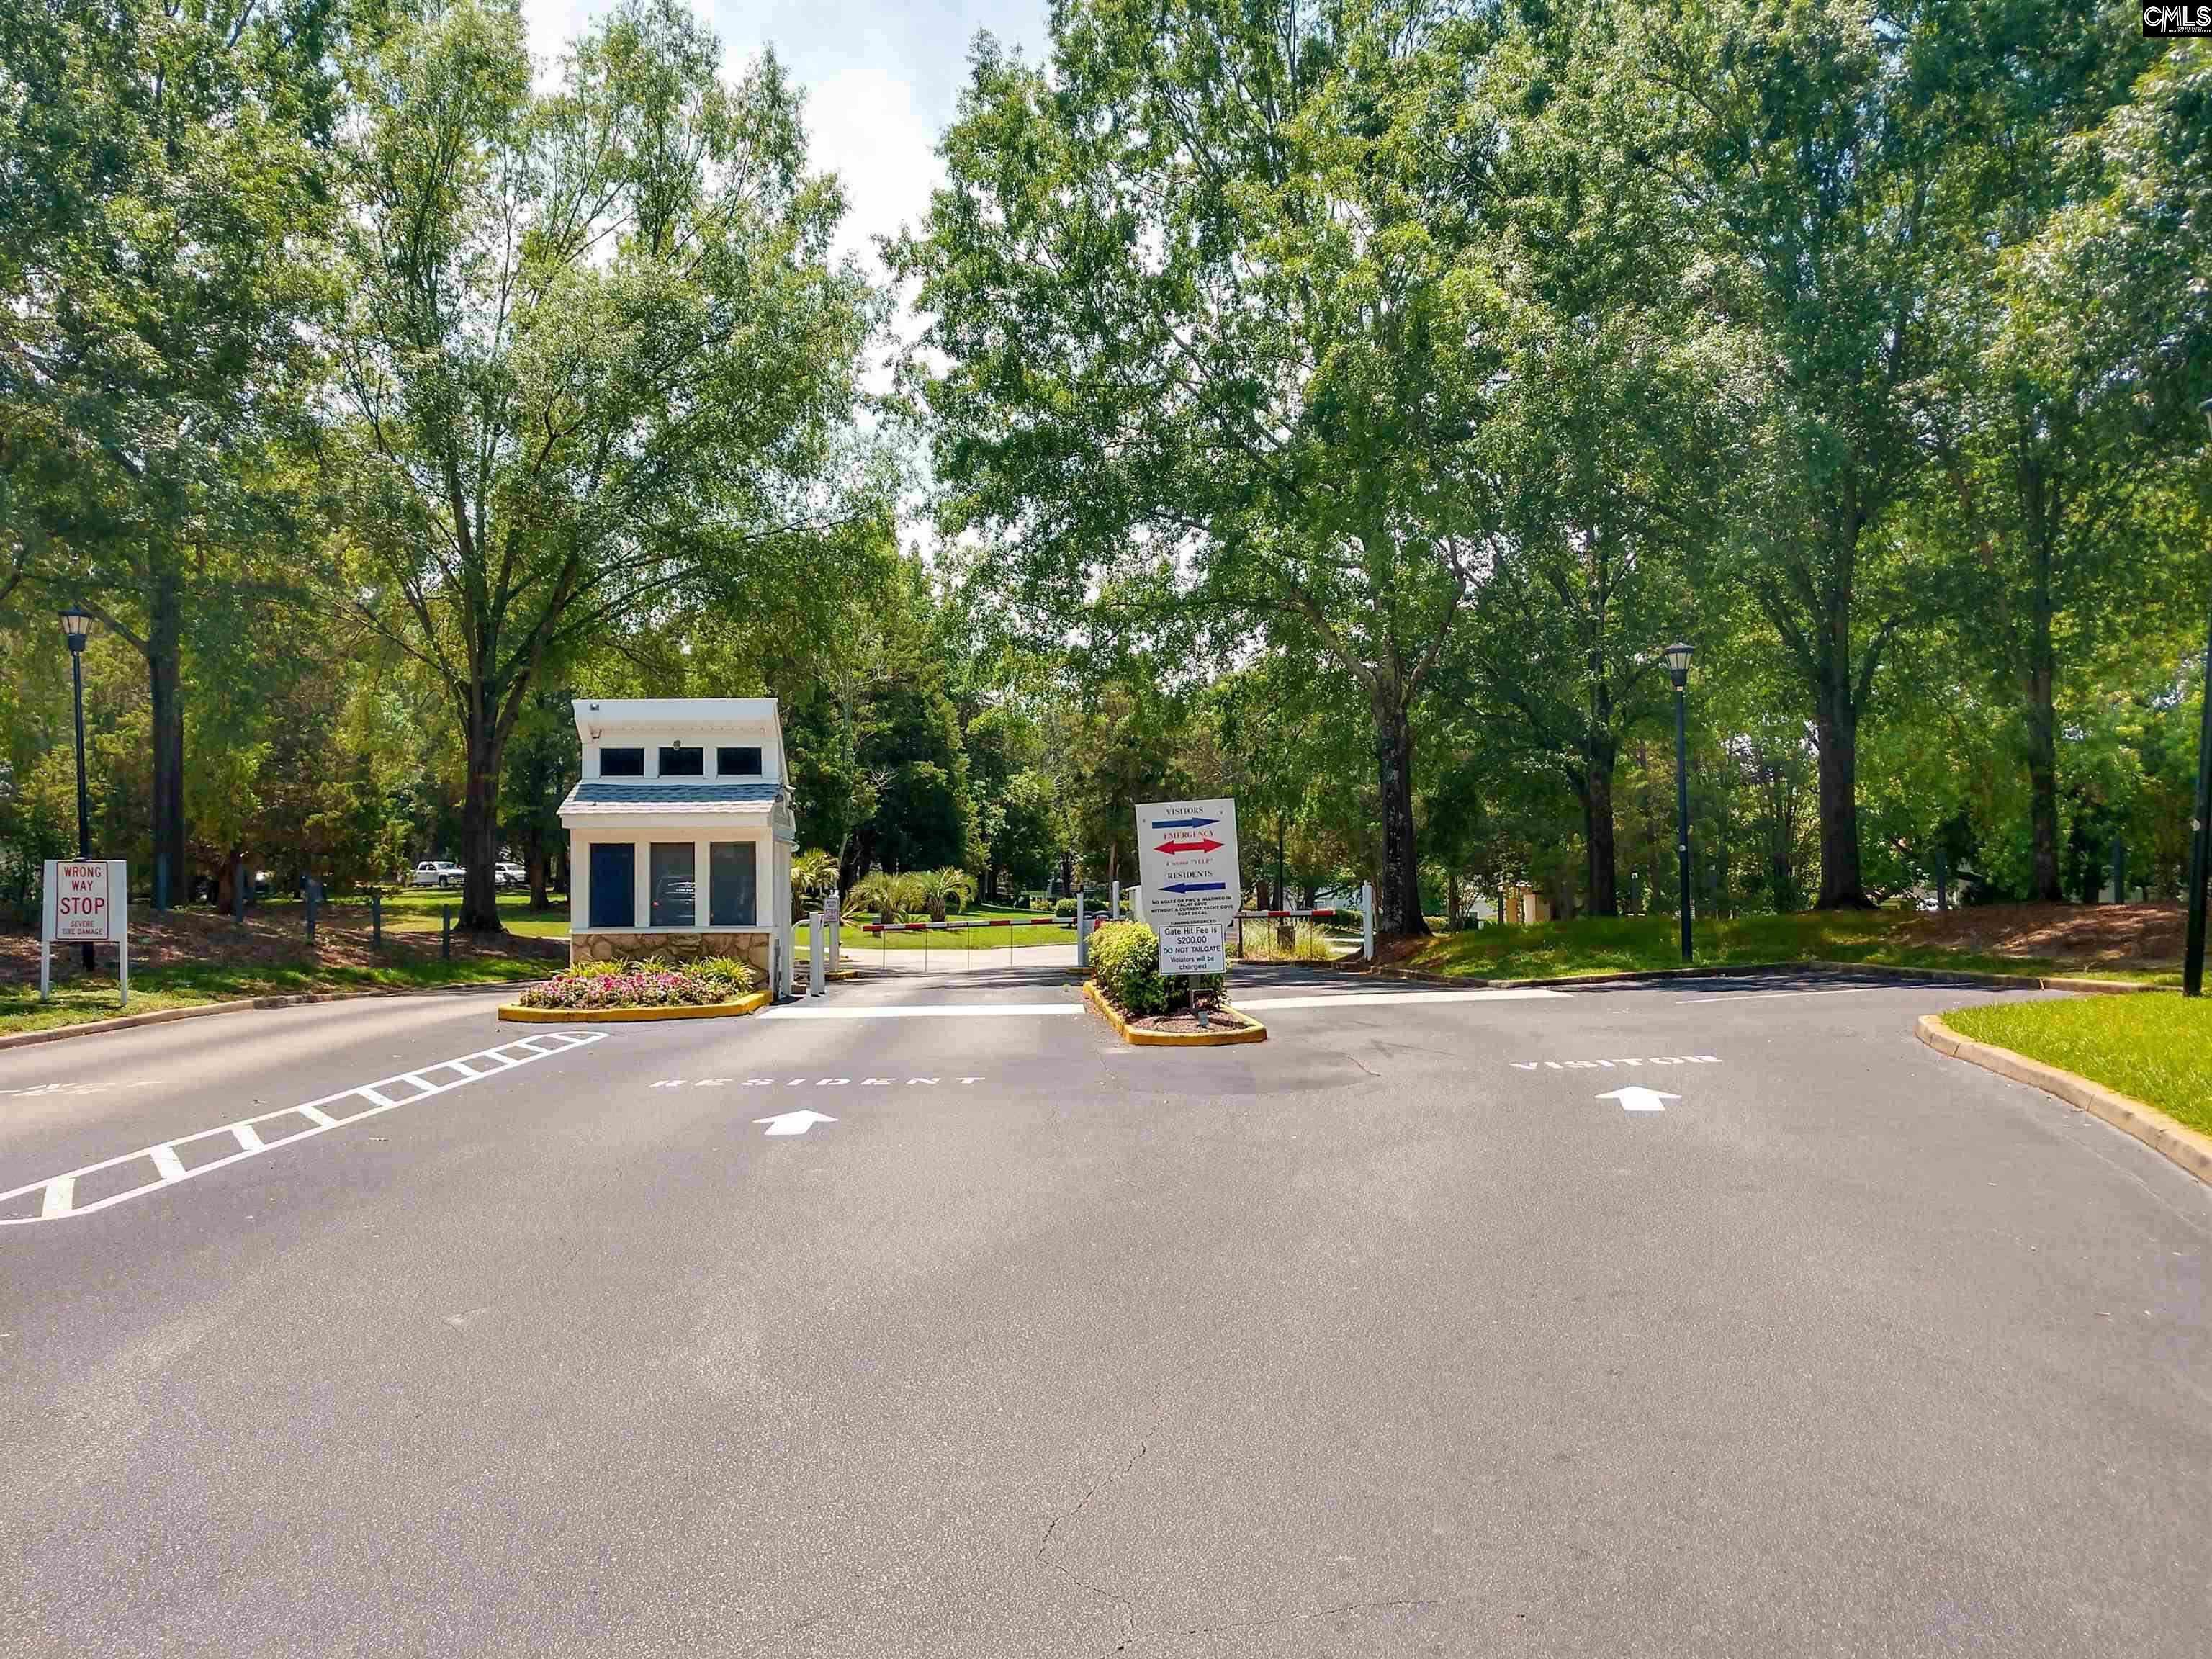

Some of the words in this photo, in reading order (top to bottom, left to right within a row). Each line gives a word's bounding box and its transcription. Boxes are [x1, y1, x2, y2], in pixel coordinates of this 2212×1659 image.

[1166, 806, 1204, 815] VISITORS
[1164, 830, 1215, 840] EMERGENCY
[64, 866, 102, 877] WRONG
[1167, 870, 1213, 879] RESIDENTS
[71, 881, 93, 891] WAY
[60, 897, 104, 914] STOP
[1177, 936, 1207, 945] $200.00
[1509, 1055, 1723, 1070] VISITOR
[647, 1076, 986, 1088] RESIDENT
